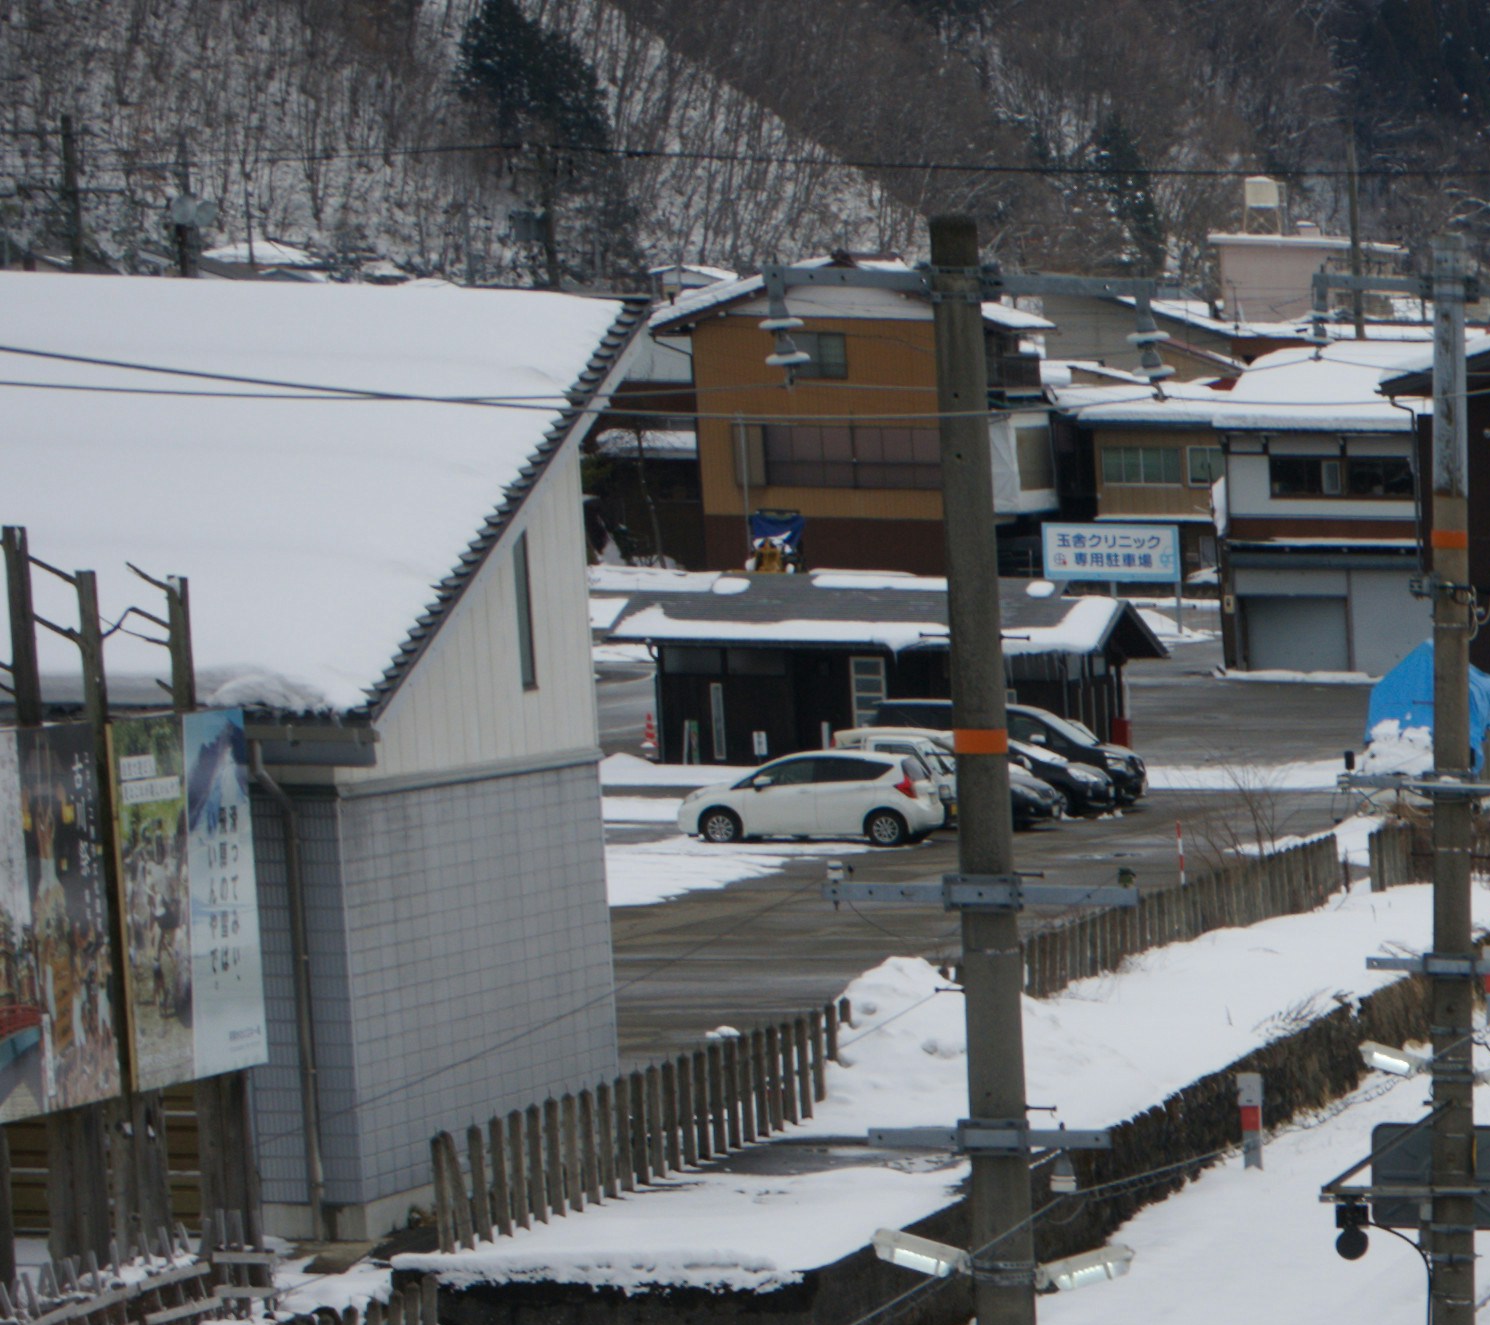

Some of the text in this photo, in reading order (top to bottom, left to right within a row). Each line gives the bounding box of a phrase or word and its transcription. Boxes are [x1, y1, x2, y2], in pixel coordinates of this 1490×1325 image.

[1056, 533, 1161, 549] 玉舎クリニック
[1074, 552, 1152, 567] 専用駐車場
